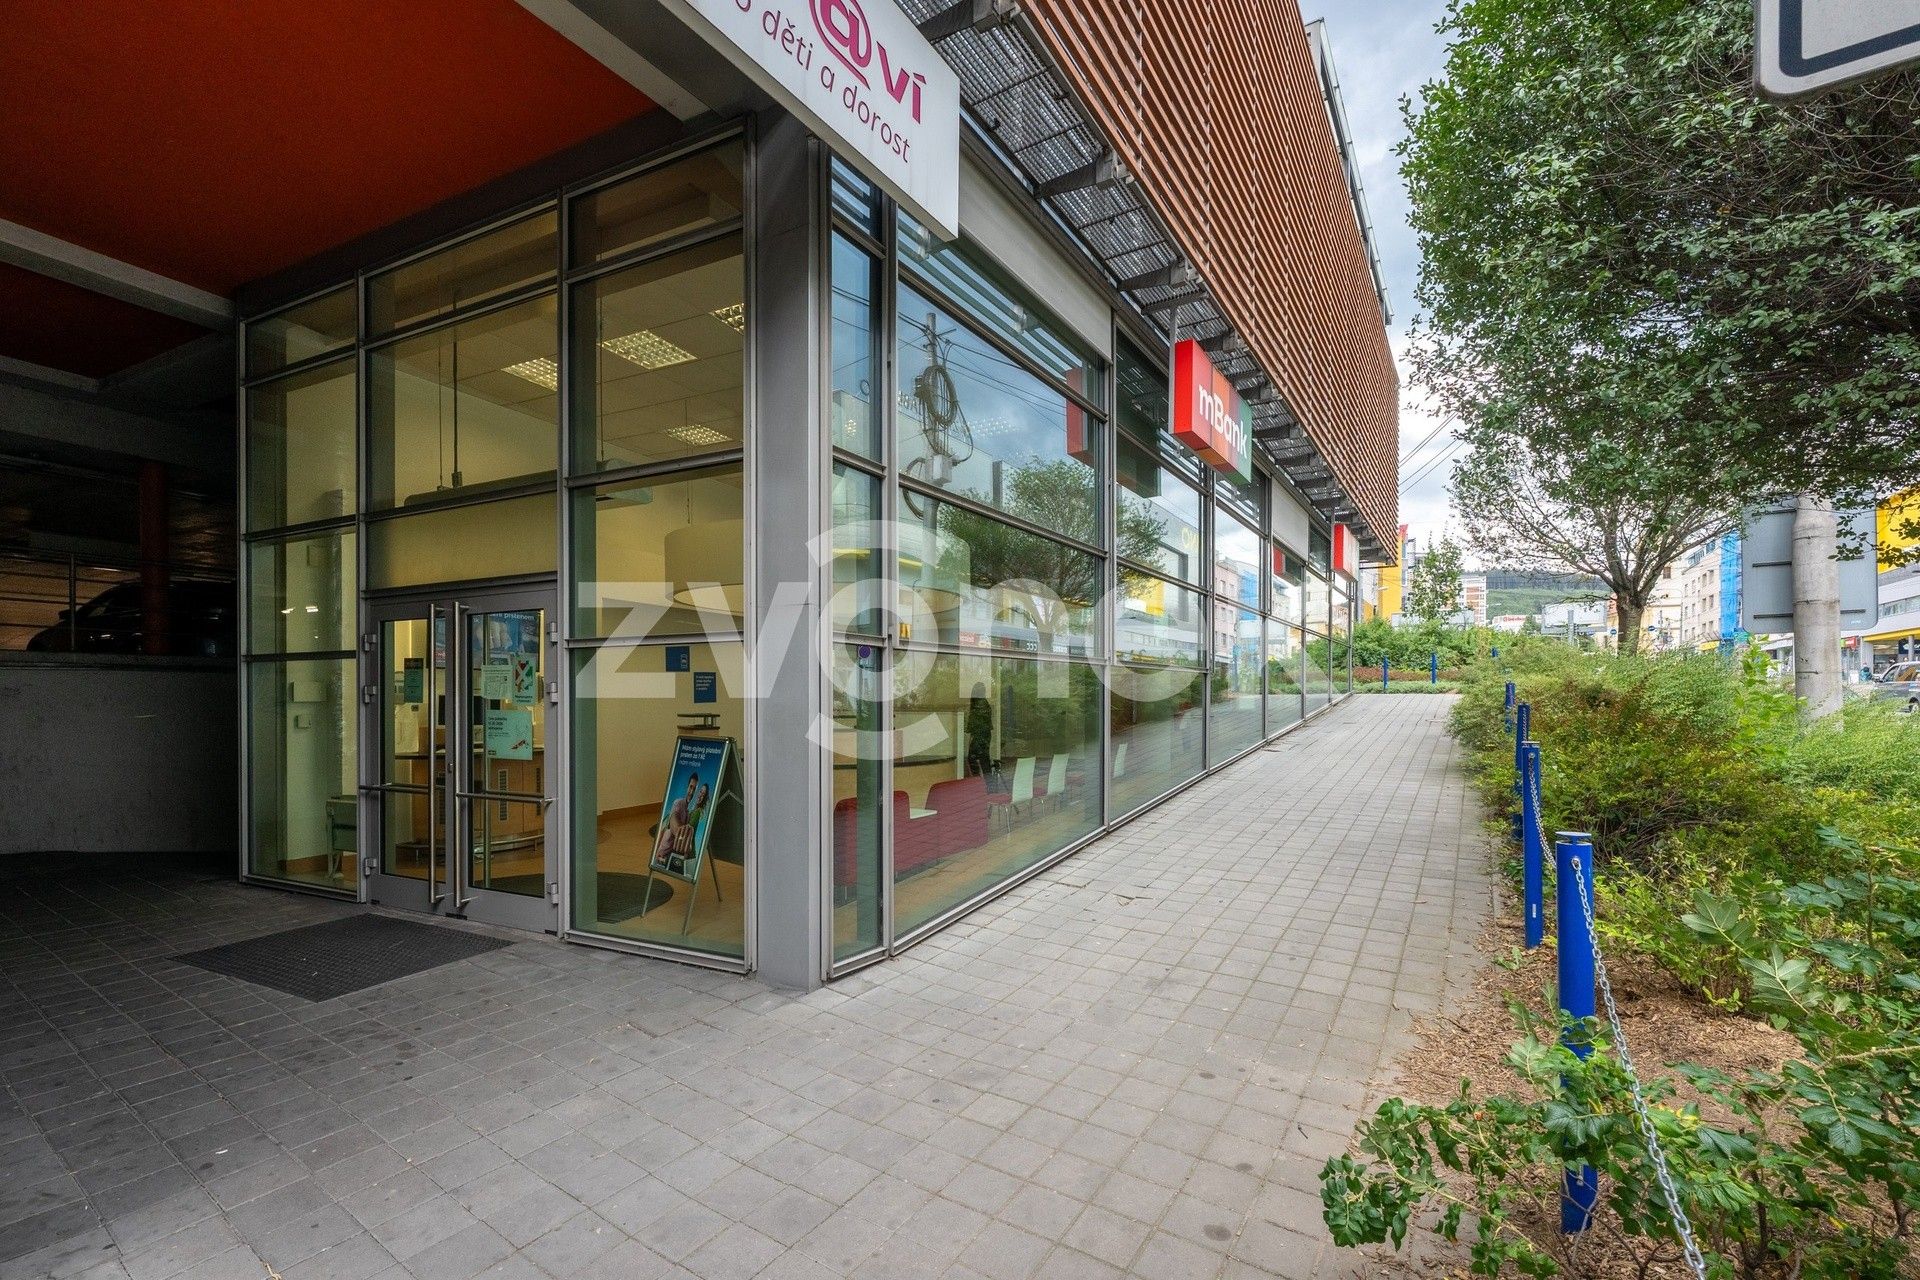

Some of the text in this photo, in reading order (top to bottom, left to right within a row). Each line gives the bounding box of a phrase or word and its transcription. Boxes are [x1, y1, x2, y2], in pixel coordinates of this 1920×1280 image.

[761, 10, 911, 163] děti a dorost
[1198, 384, 1248, 459] mBank
